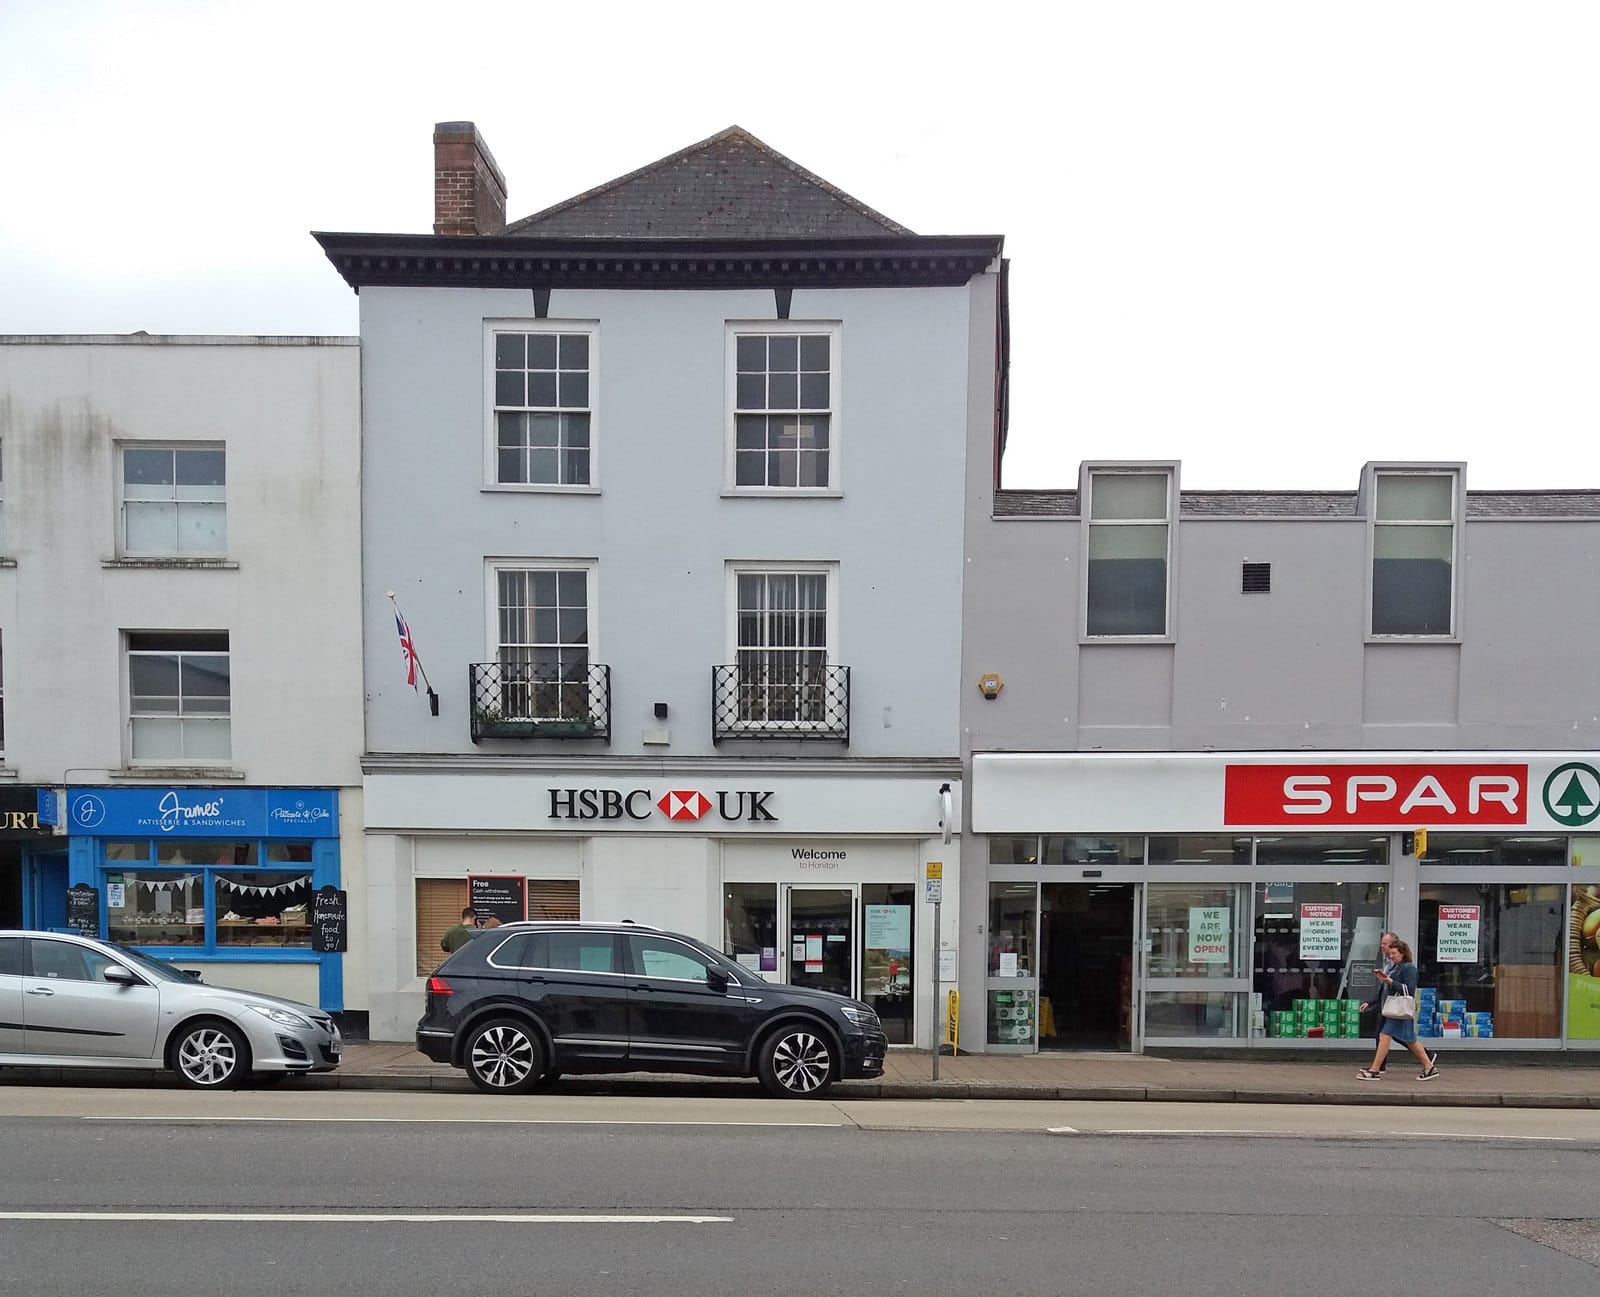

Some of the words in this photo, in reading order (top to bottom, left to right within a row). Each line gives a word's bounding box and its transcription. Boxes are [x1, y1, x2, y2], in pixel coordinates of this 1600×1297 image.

[1282, 775, 1520, 815] SPAR
[547, 788, 652, 820] HSBC
[715, 791, 779, 821] UK
[138, 818, 181, 827] PATISSERIE
[183, 818, 189, 826] &
[191, 819, 246, 827] SANDWICHES
[791, 848, 847, 860] Welcome
[799, 862, 808, 870] to
[472, 880, 489, 888] Free
[1202, 911, 1221, 920] WE
[1200, 922, 1221, 930] ARE
[325, 933, 334, 942] to
[1196, 933, 1223, 943] NOW
[1193, 945, 1226, 954] OPEN!
